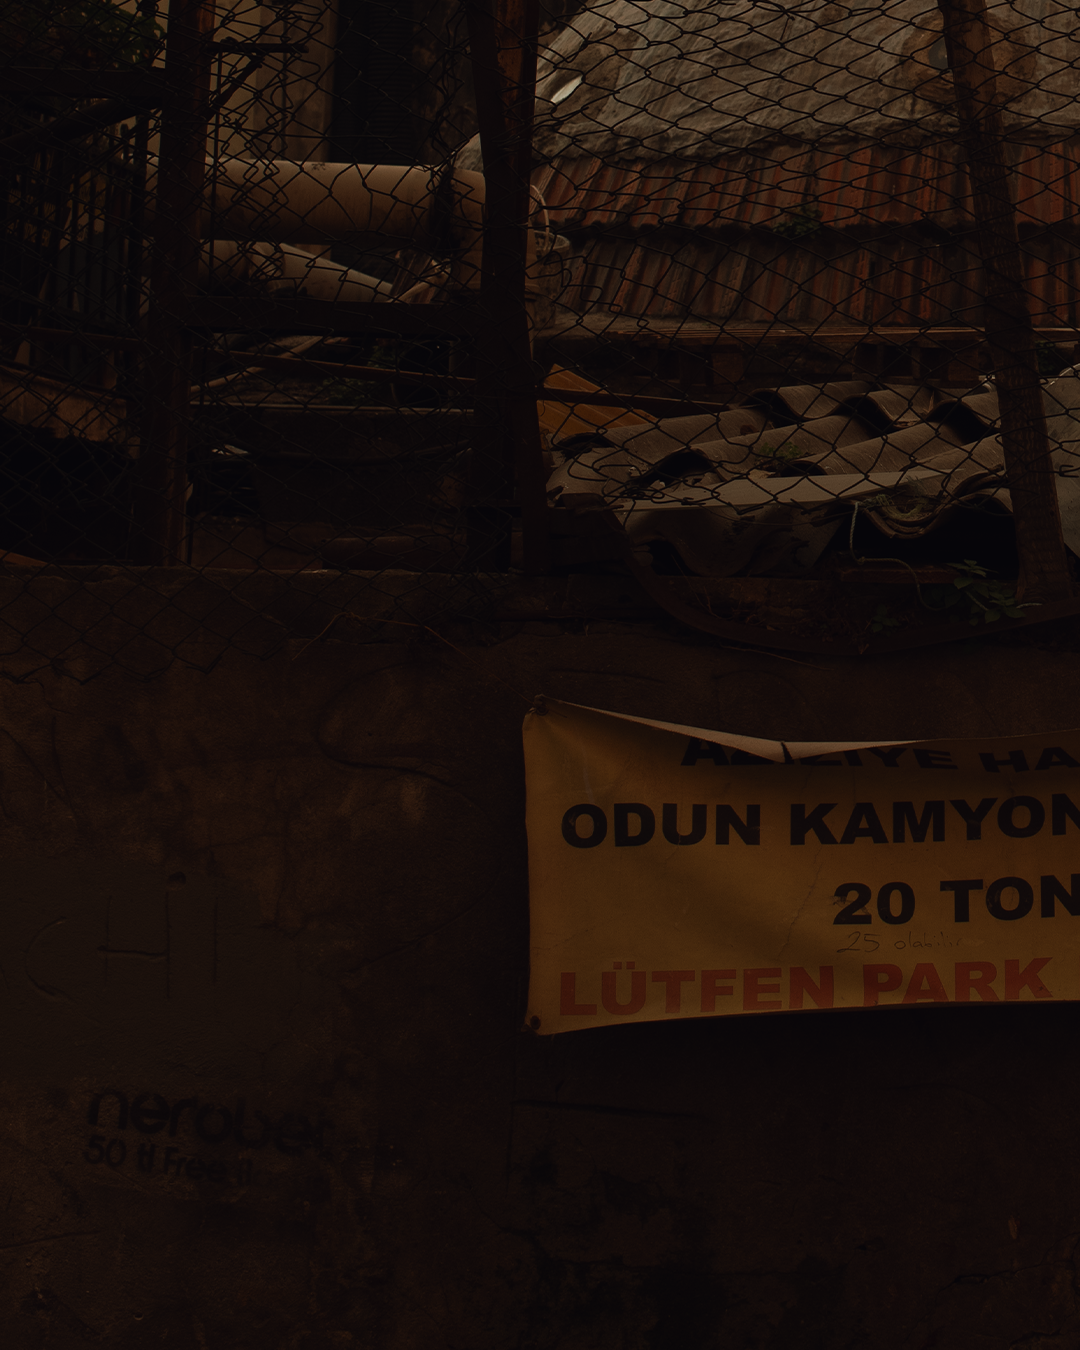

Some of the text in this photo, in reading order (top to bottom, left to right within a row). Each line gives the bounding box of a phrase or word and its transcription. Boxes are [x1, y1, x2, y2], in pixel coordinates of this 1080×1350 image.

[561, 802, 761, 849] ODUN
[833, 881, 916, 926] 20
[836, 930, 882, 954] 25
[559, 960, 835, 1017] LÜTFEN
[862, 956, 1054, 1008] PARK
[82, 1133, 128, 1169] 50
[162, 1146, 228, 1183] Free
